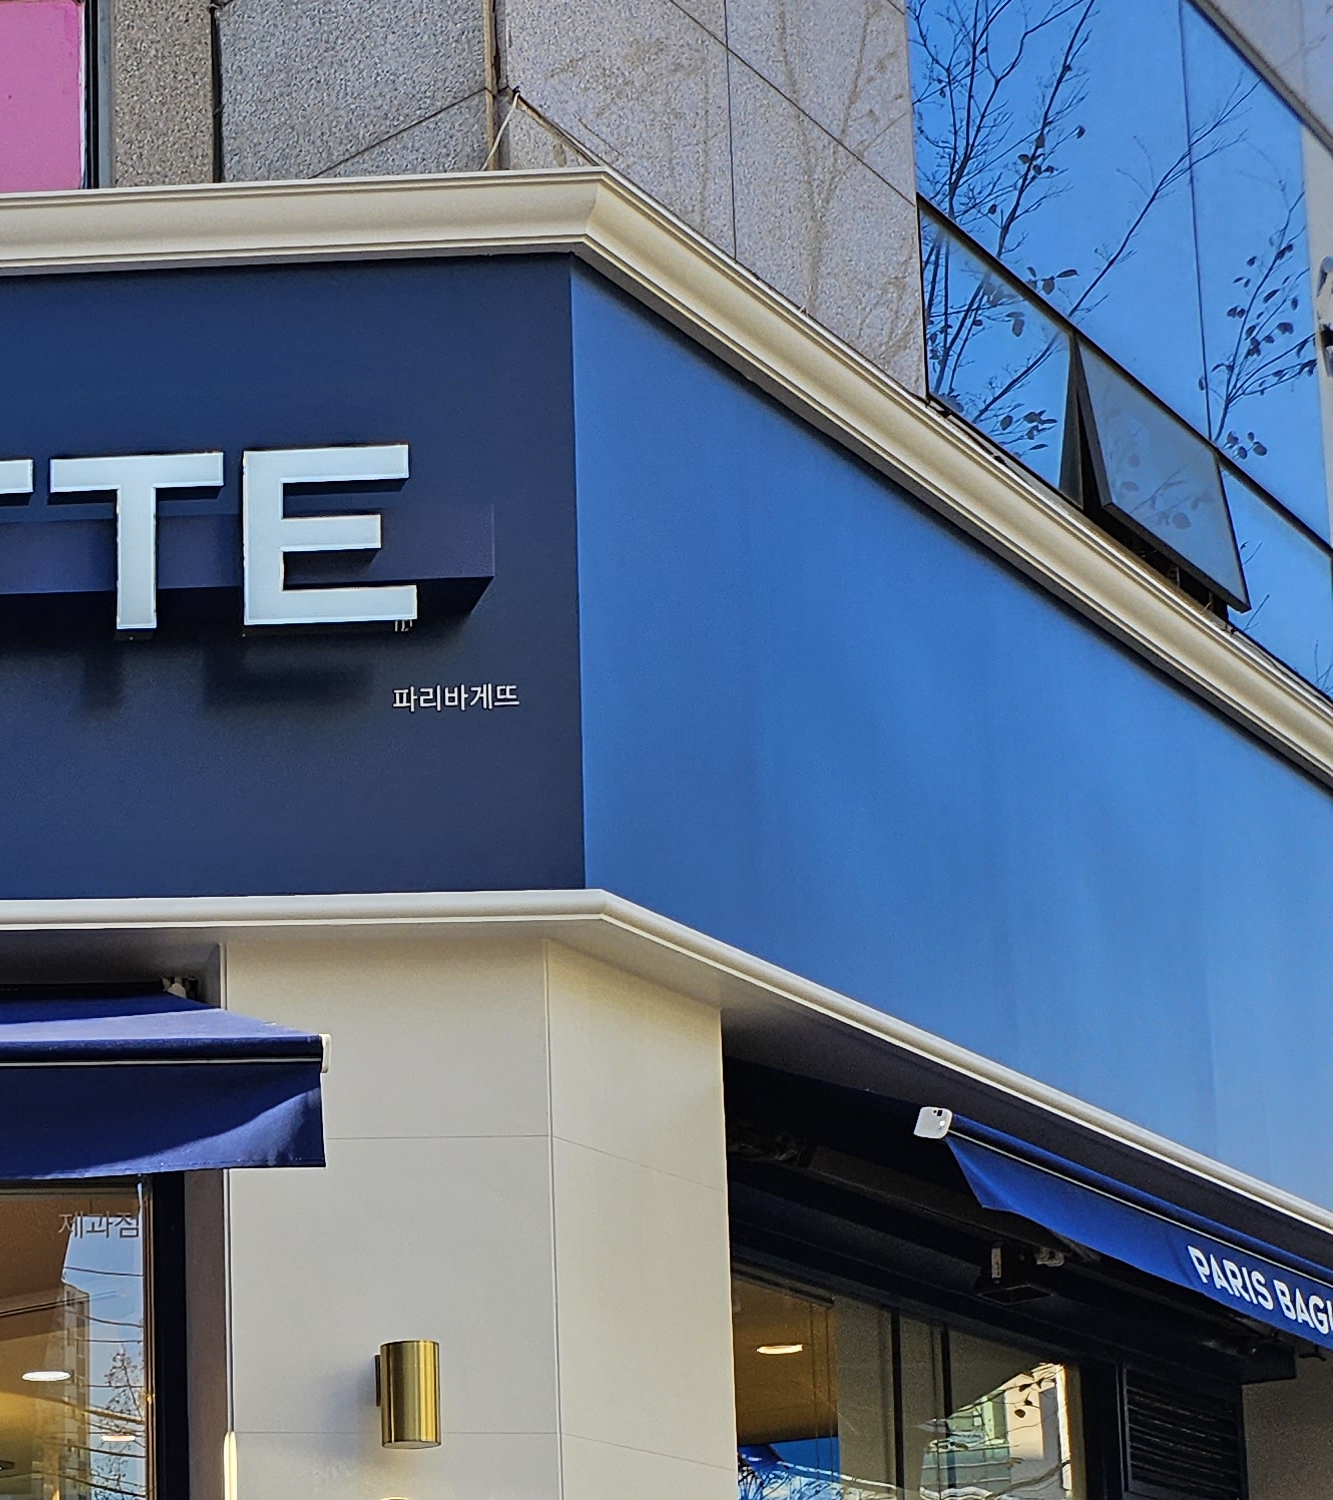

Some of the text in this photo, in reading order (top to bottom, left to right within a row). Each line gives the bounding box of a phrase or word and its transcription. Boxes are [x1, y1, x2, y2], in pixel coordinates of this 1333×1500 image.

[391, 682, 521, 713] 파리바게뜨
[57, 1211, 141, 1239] 제과점
[1186, 1244, 1333, 1335] PARIS BAG
